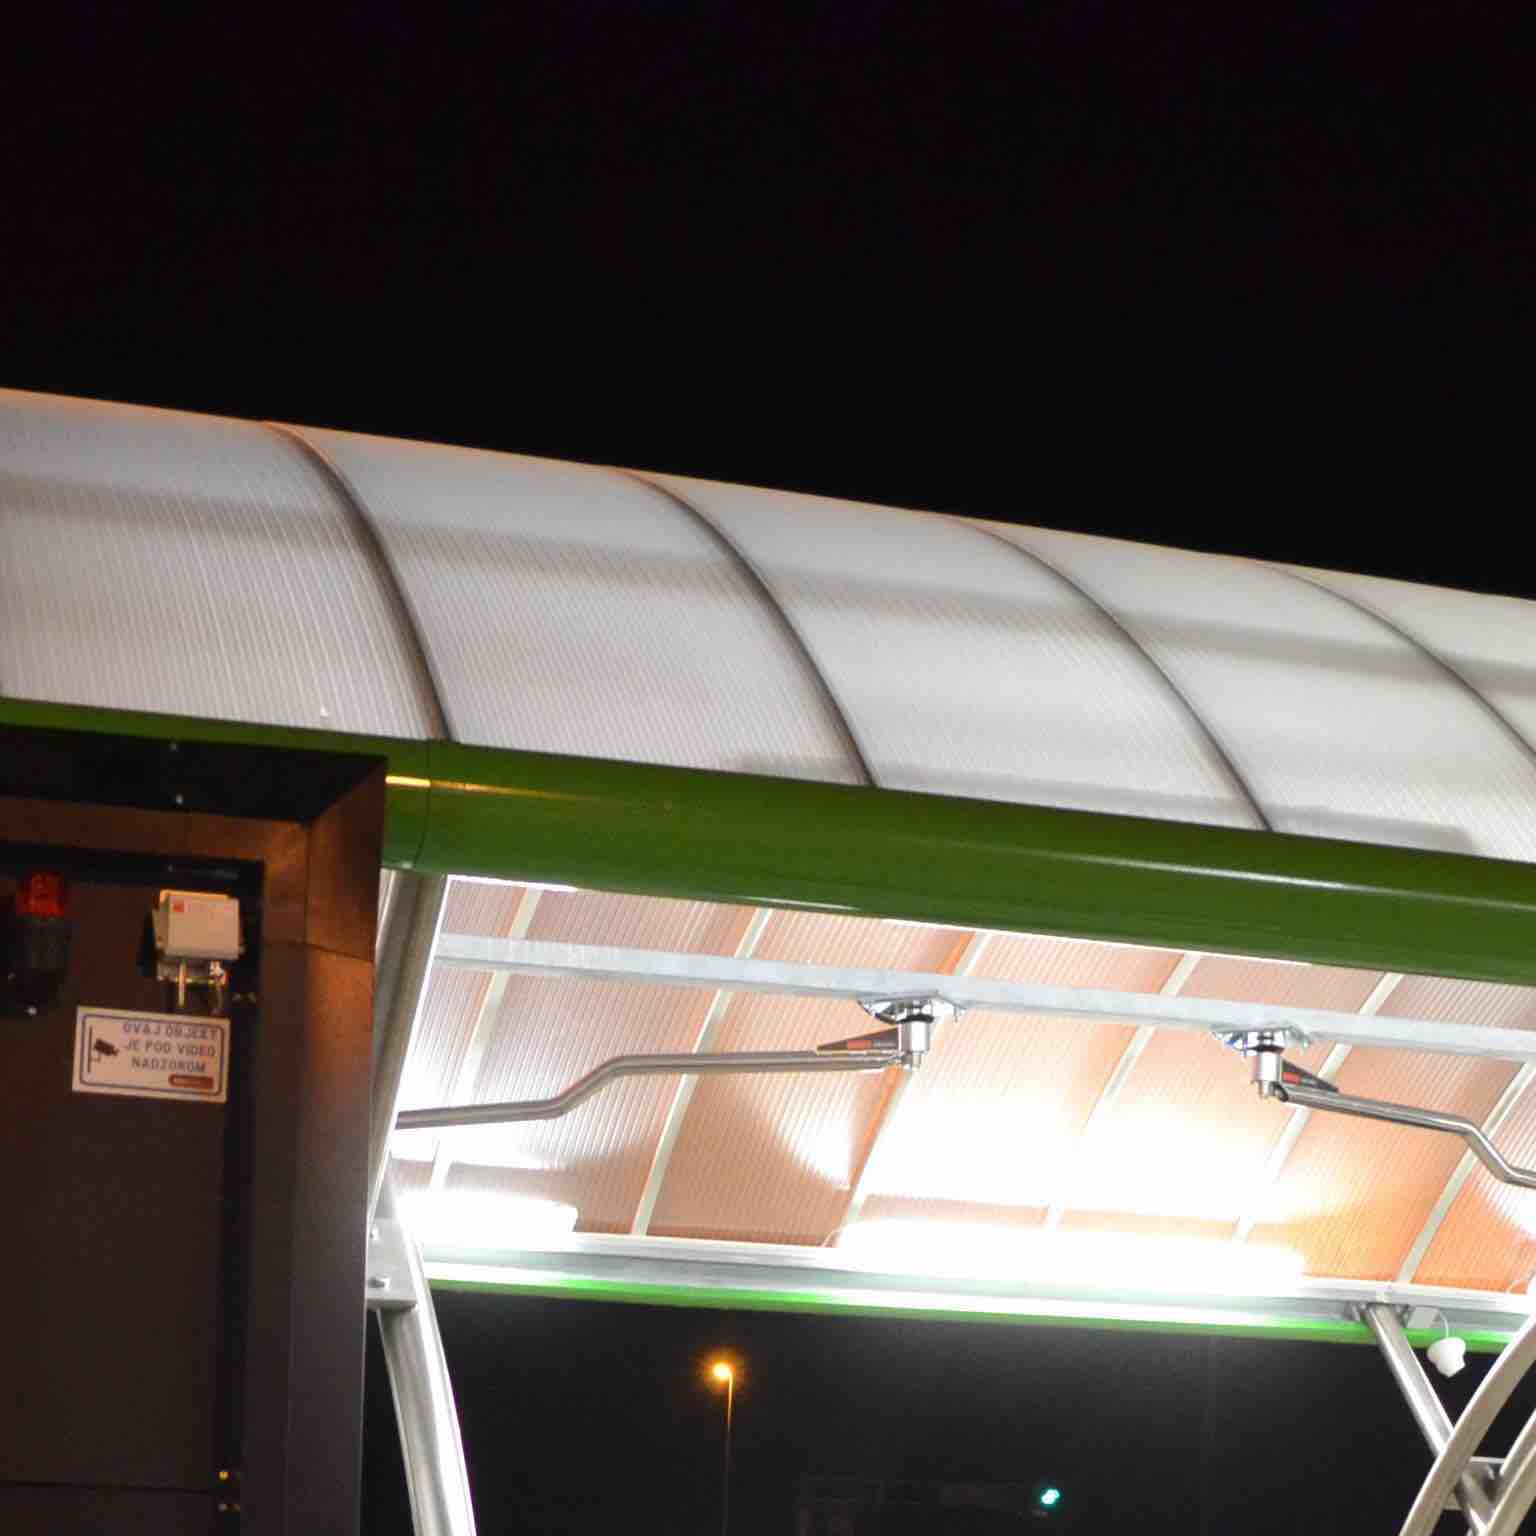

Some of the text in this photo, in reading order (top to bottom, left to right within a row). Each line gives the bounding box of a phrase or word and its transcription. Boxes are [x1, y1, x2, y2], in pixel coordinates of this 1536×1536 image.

[122, 1022, 218, 1041] OVAJ OBJEKT
[145, 1040, 172, 1054] POD
[177, 1043, 217, 1057] VIDEO
[131, 1056, 206, 1073] NADZOROM
